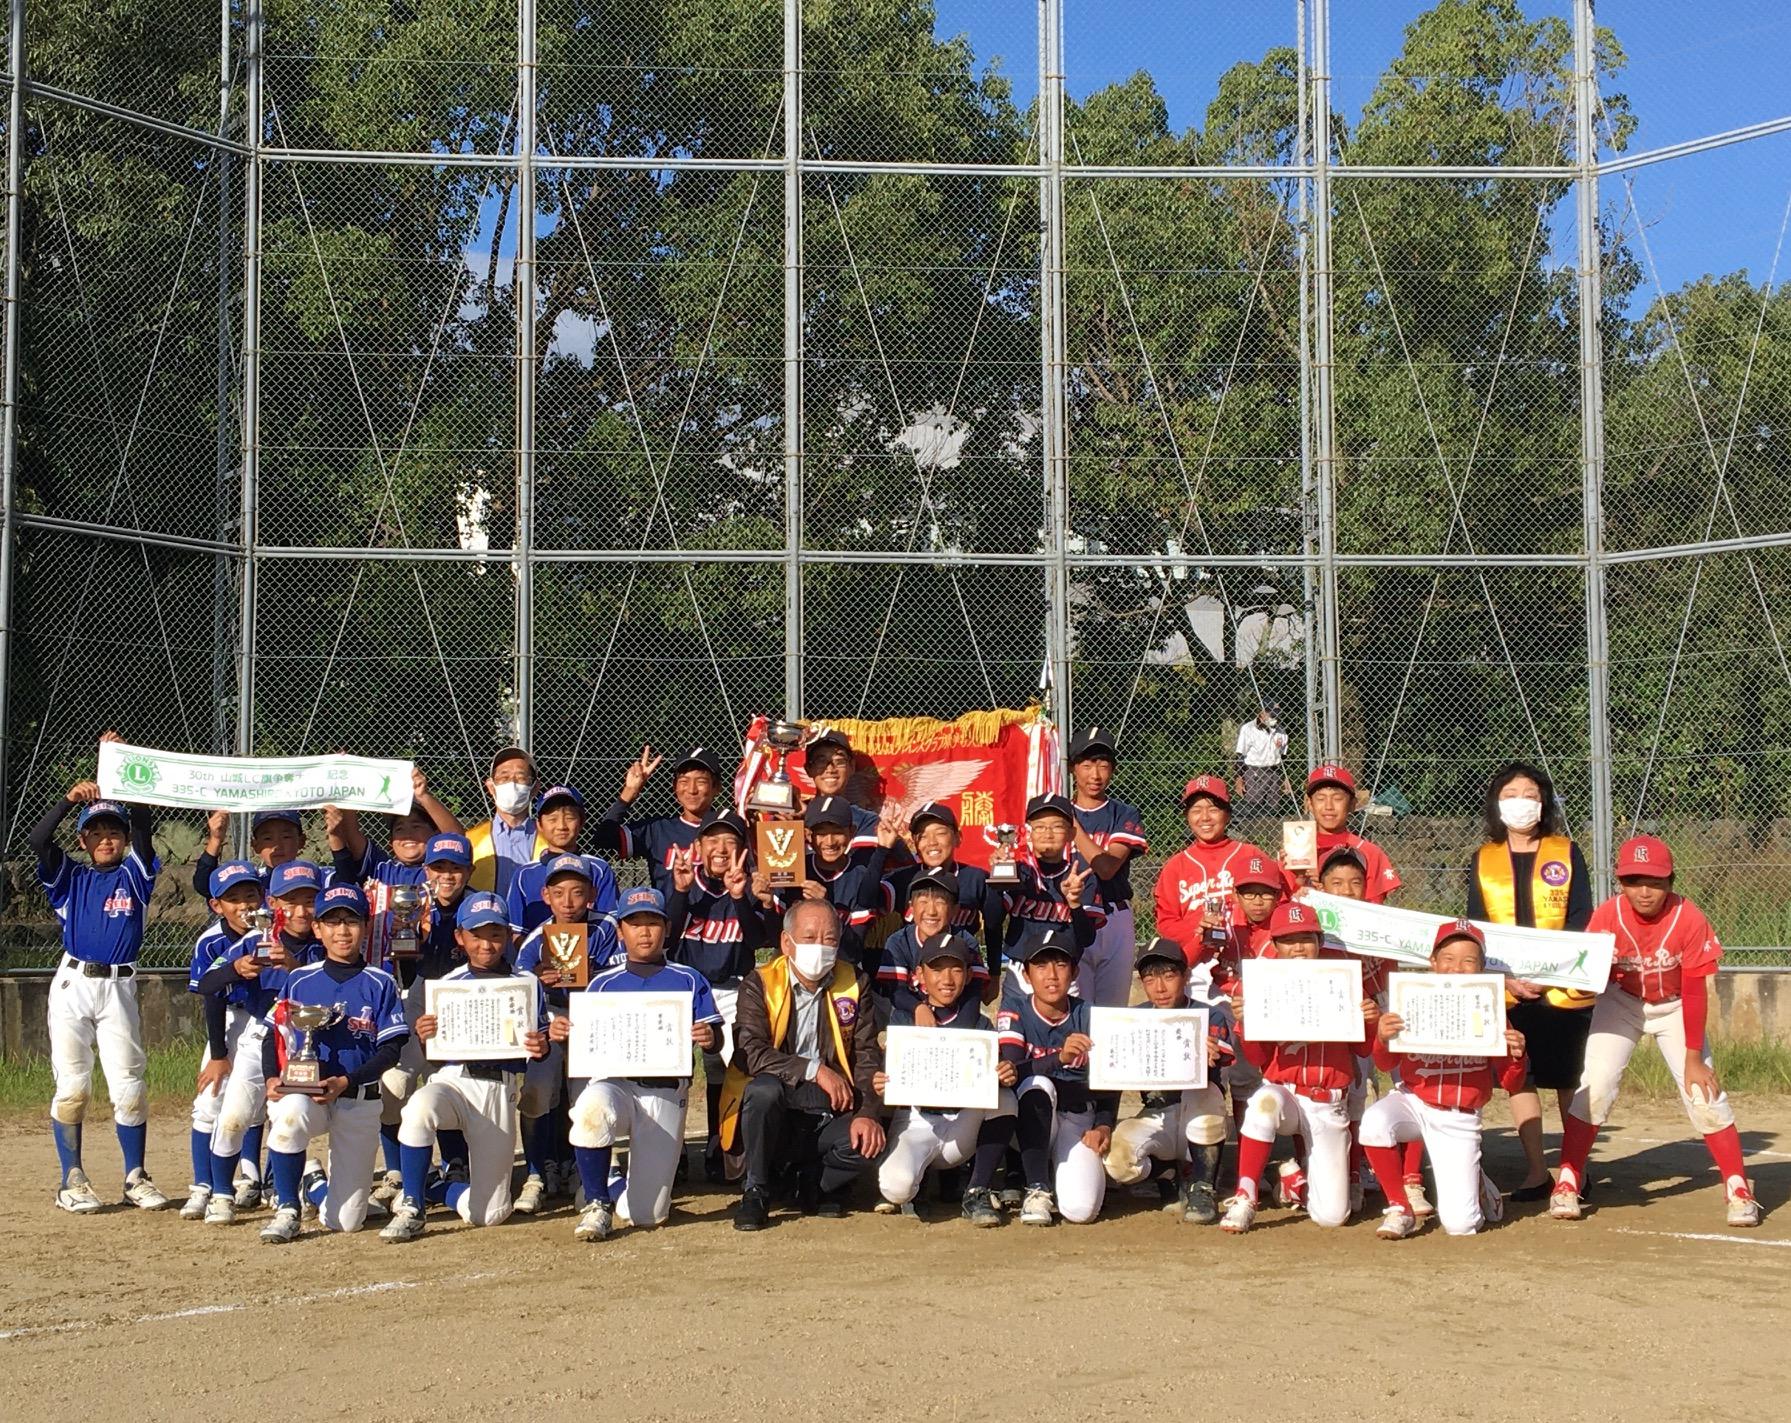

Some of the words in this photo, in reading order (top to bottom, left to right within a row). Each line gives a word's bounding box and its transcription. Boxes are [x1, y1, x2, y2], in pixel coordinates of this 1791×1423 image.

[329, 786, 365, 798] JAPAN
[324, 887, 359, 901] SEIKA
[1357, 929, 1391, 945] 335-C
[1519, 960, 1559, 972] JAPAN
